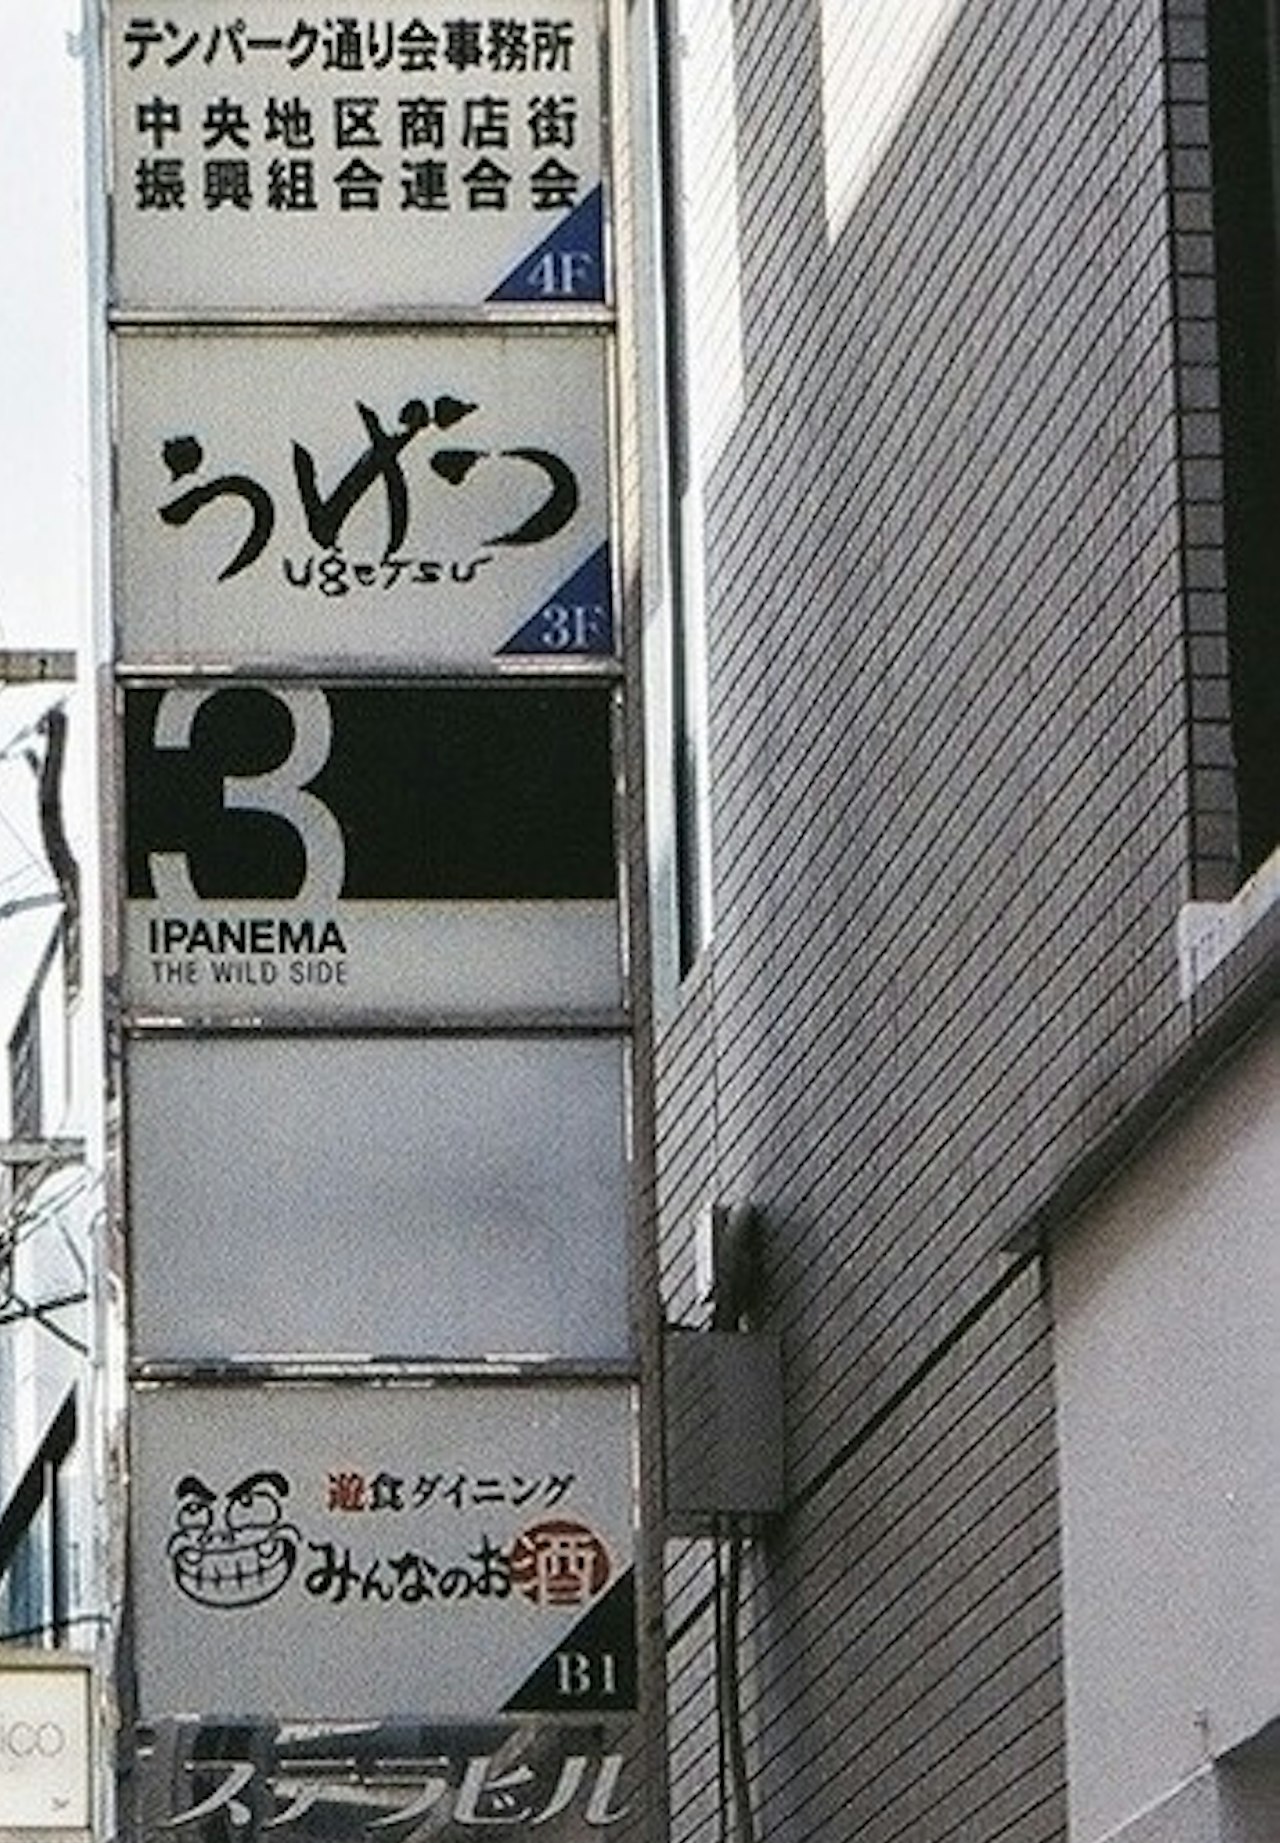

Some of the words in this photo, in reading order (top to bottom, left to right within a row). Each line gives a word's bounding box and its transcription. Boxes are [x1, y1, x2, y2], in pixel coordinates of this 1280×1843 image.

[125, 19, 574, 72] テンパーク通り会事務所
[138, 97, 578, 149] 中央地区商店街
[137, 158, 578, 211] 振興組合連合会
[528, 252, 592, 294] 4F
[149, 685, 346, 901] 3
[149, 919, 346, 954] IPANEMA
[152, 961, 197, 984] THE
[213, 961, 277, 984] WILD
[290, 961, 348, 984] SIDE
[167, 1755, 632, 1828] ステラビル
